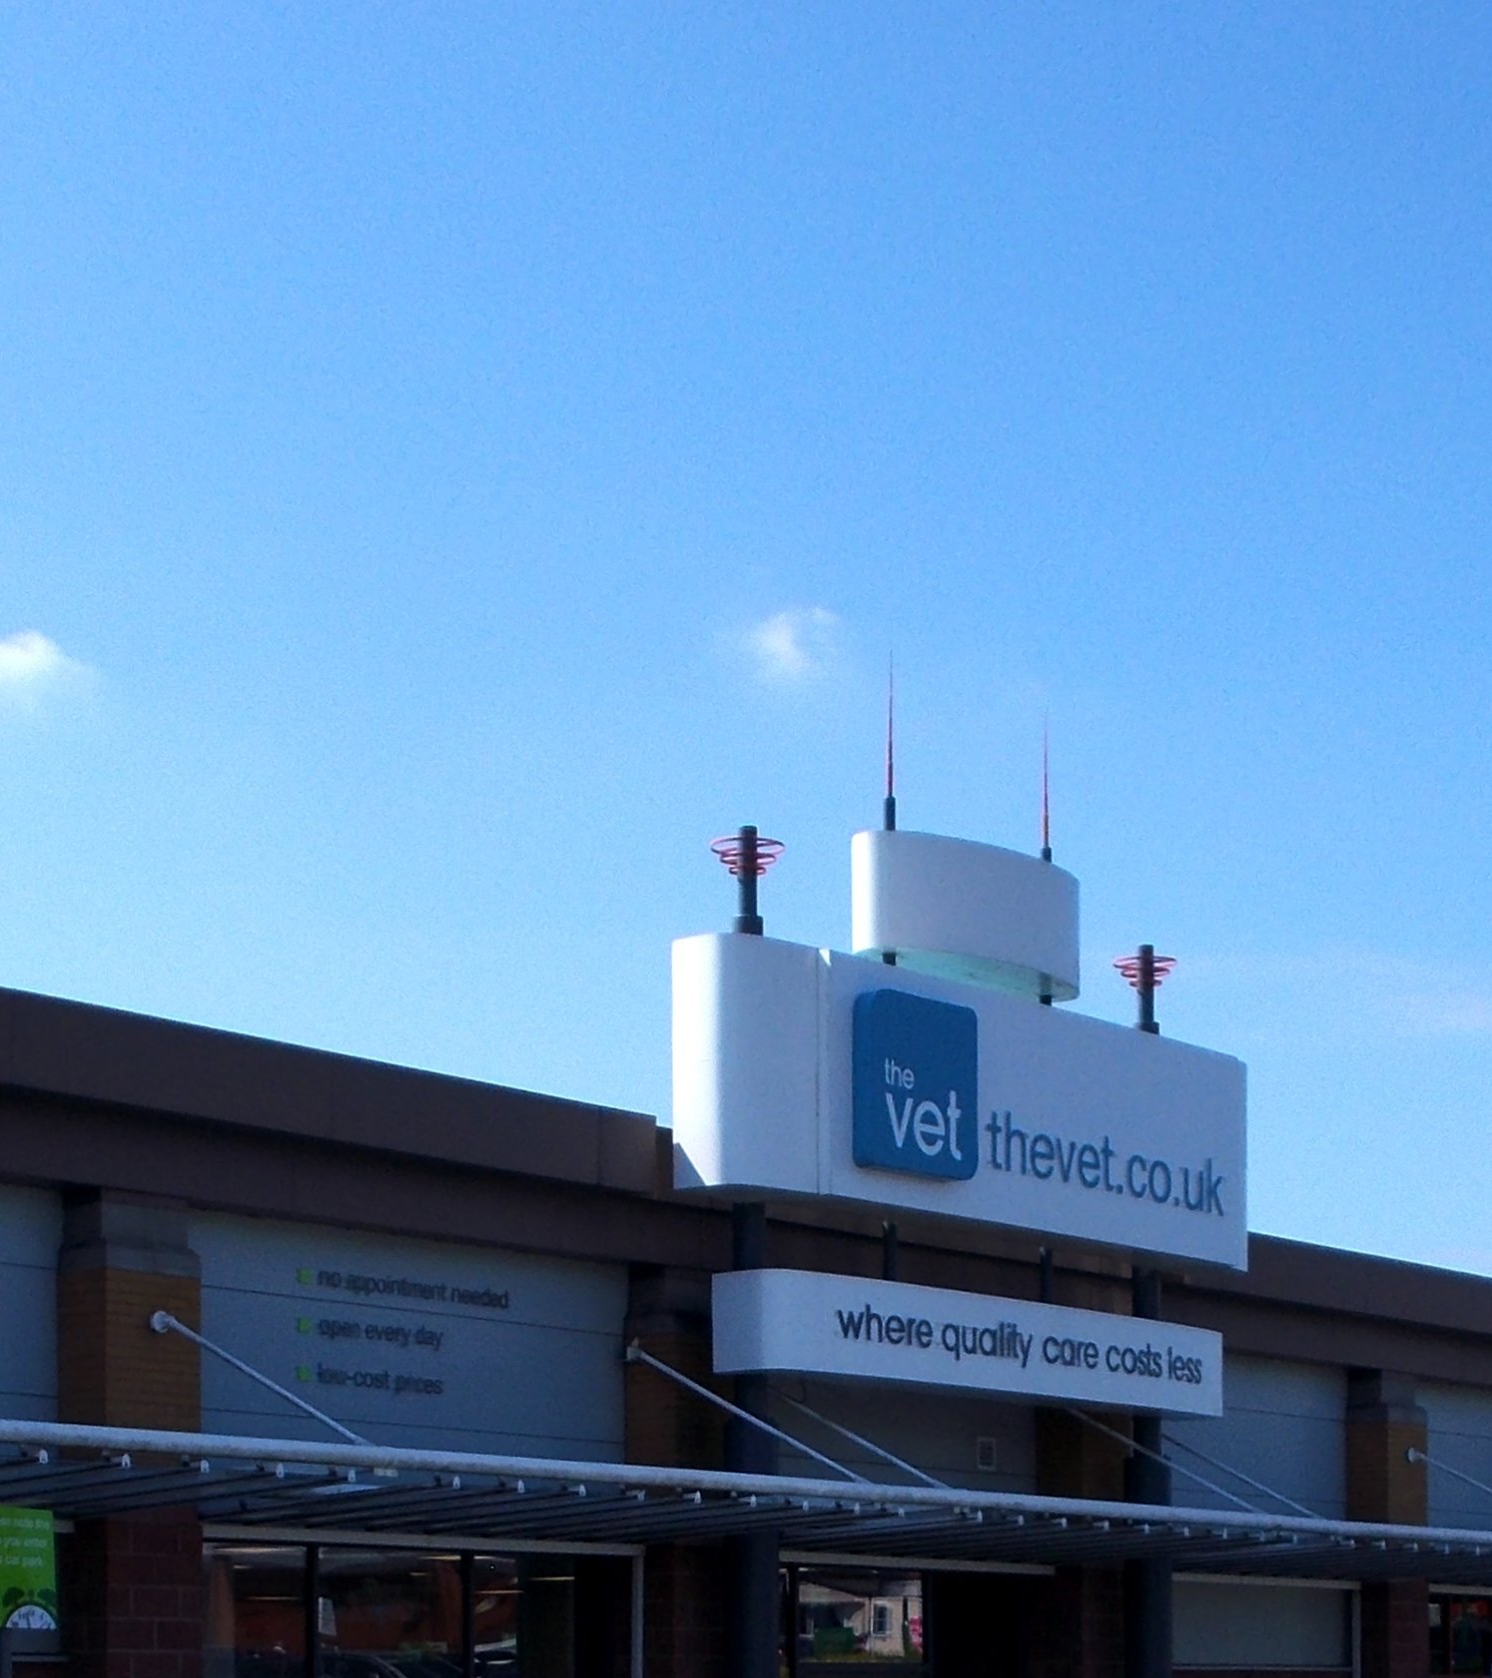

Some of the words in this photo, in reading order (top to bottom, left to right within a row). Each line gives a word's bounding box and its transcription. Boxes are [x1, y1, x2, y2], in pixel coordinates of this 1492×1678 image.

[884, 1057, 915, 1090] the
[885, 1089, 963, 1161] vet
[984, 1111, 1225, 1217] thevet.co.uk
[317, 1270, 342, 1289] no
[345, 1273, 448, 1302] appointment
[450, 1286, 509, 1310] needed
[318, 1318, 361, 1340] open
[364, 1323, 412, 1349] every
[413, 1323, 444, 1351] day
[838, 1303, 933, 1349] where
[941, 1321, 1033, 1368] quality
[1042, 1334, 1099, 1369] care
[1105, 1340, 1164, 1379] costs
[1168, 1346, 1203, 1386] less
[317, 1362, 390, 1390] low-cost
[393, 1371, 445, 1396] prices
